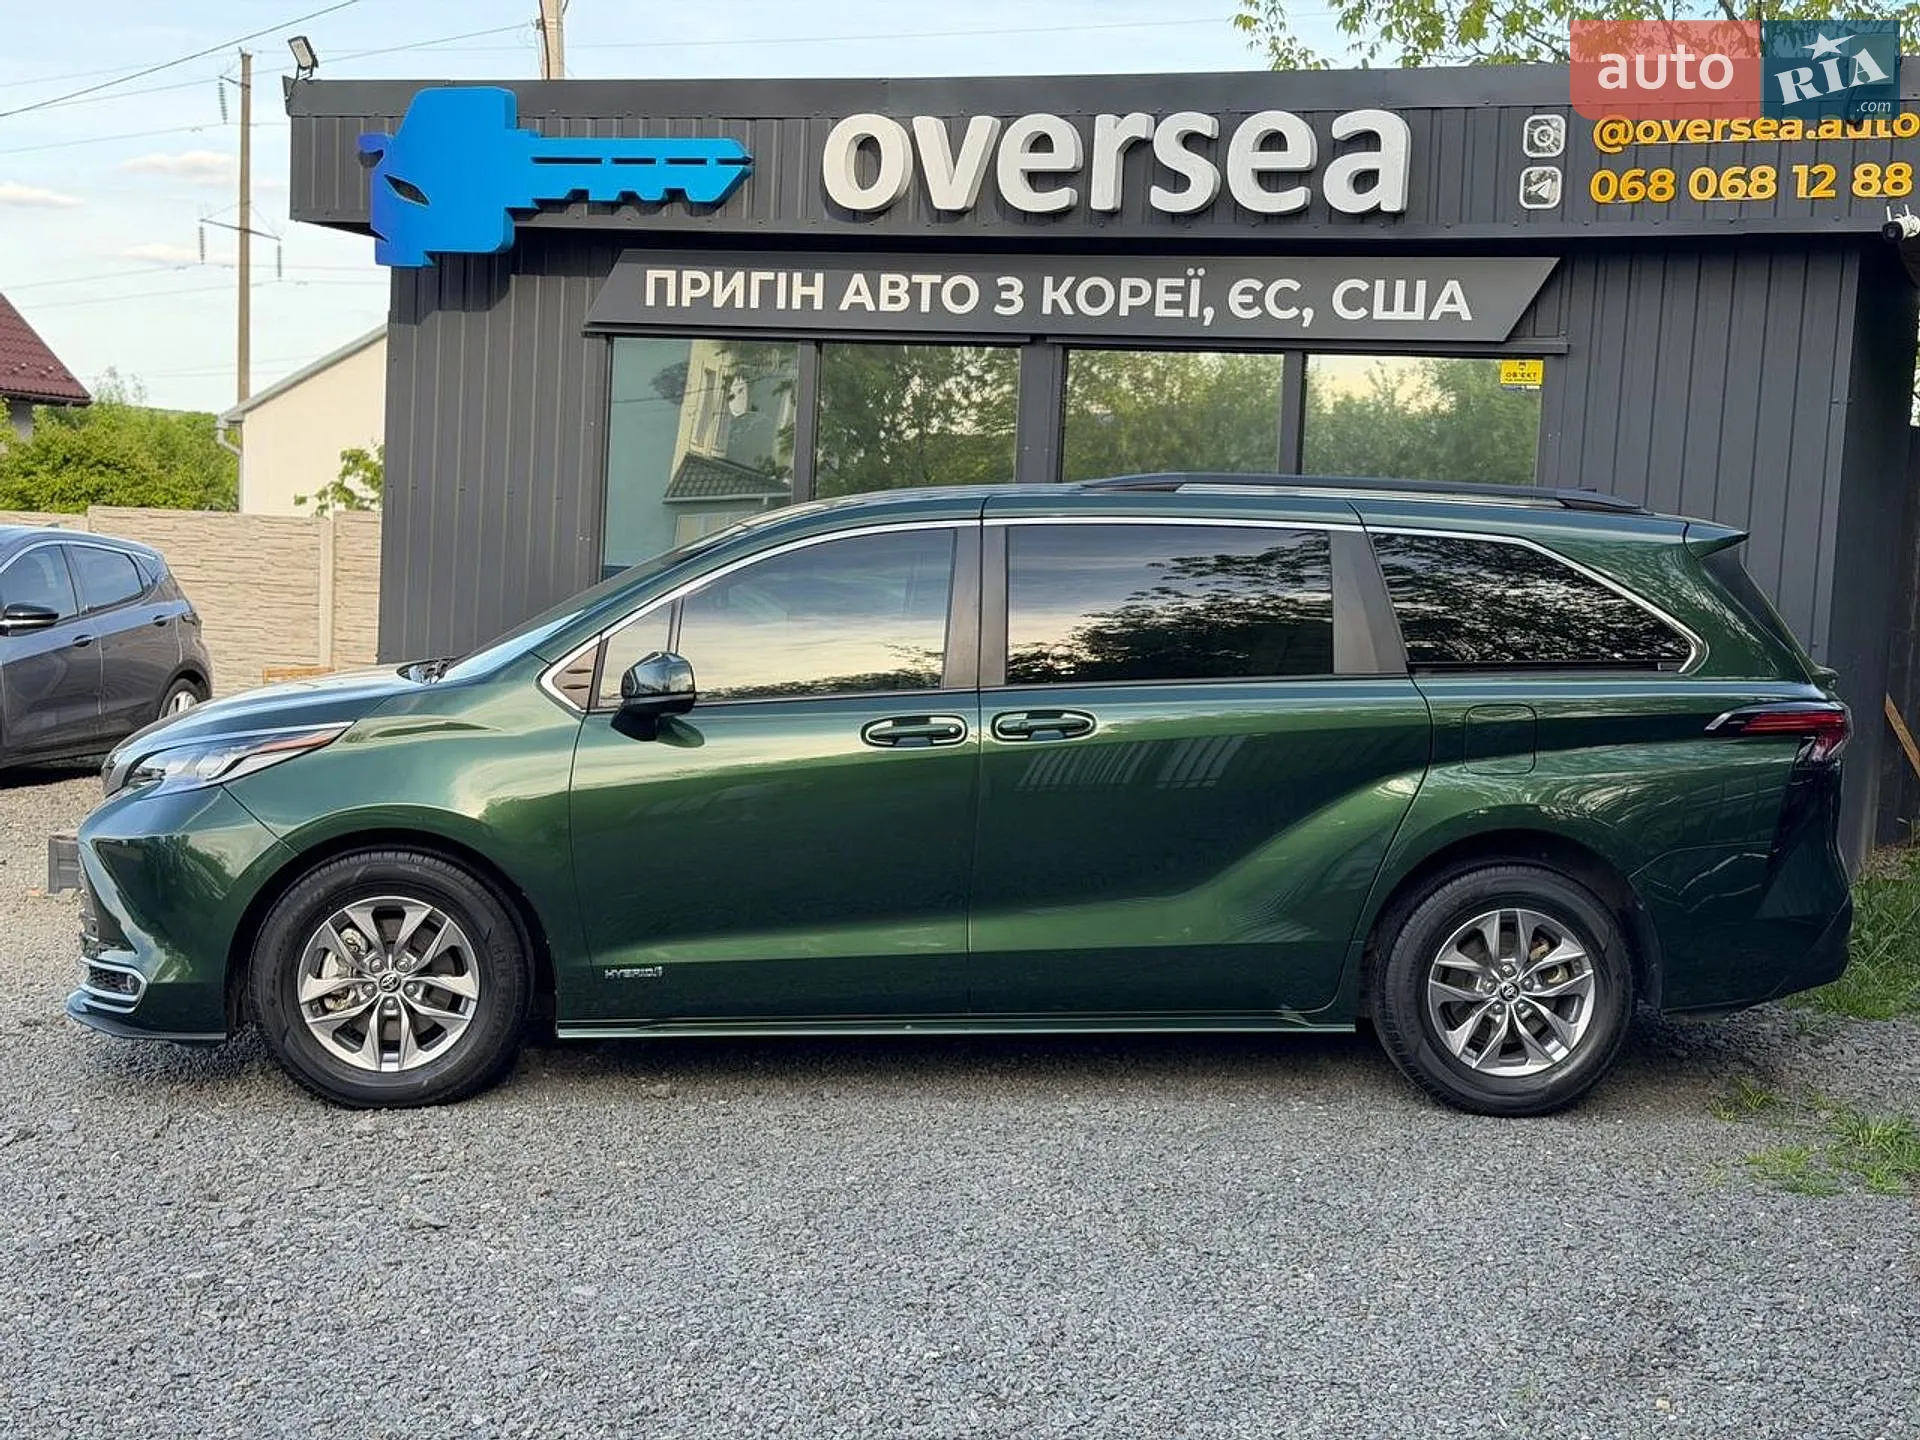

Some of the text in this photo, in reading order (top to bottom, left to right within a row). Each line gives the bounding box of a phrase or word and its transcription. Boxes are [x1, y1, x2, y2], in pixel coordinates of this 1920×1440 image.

[822, 109, 1411, 215] oversea
[1590, 161, 1914, 204] 068 068 12 88
[645, 269, 824, 310] ПРИГІН
[839, 272, 980, 315] АВТО
[1041, 267, 1214, 326] КОРЕЇ,
[1227, 277, 1315, 328] ЄС,
[1332, 278, 1472, 322] США
